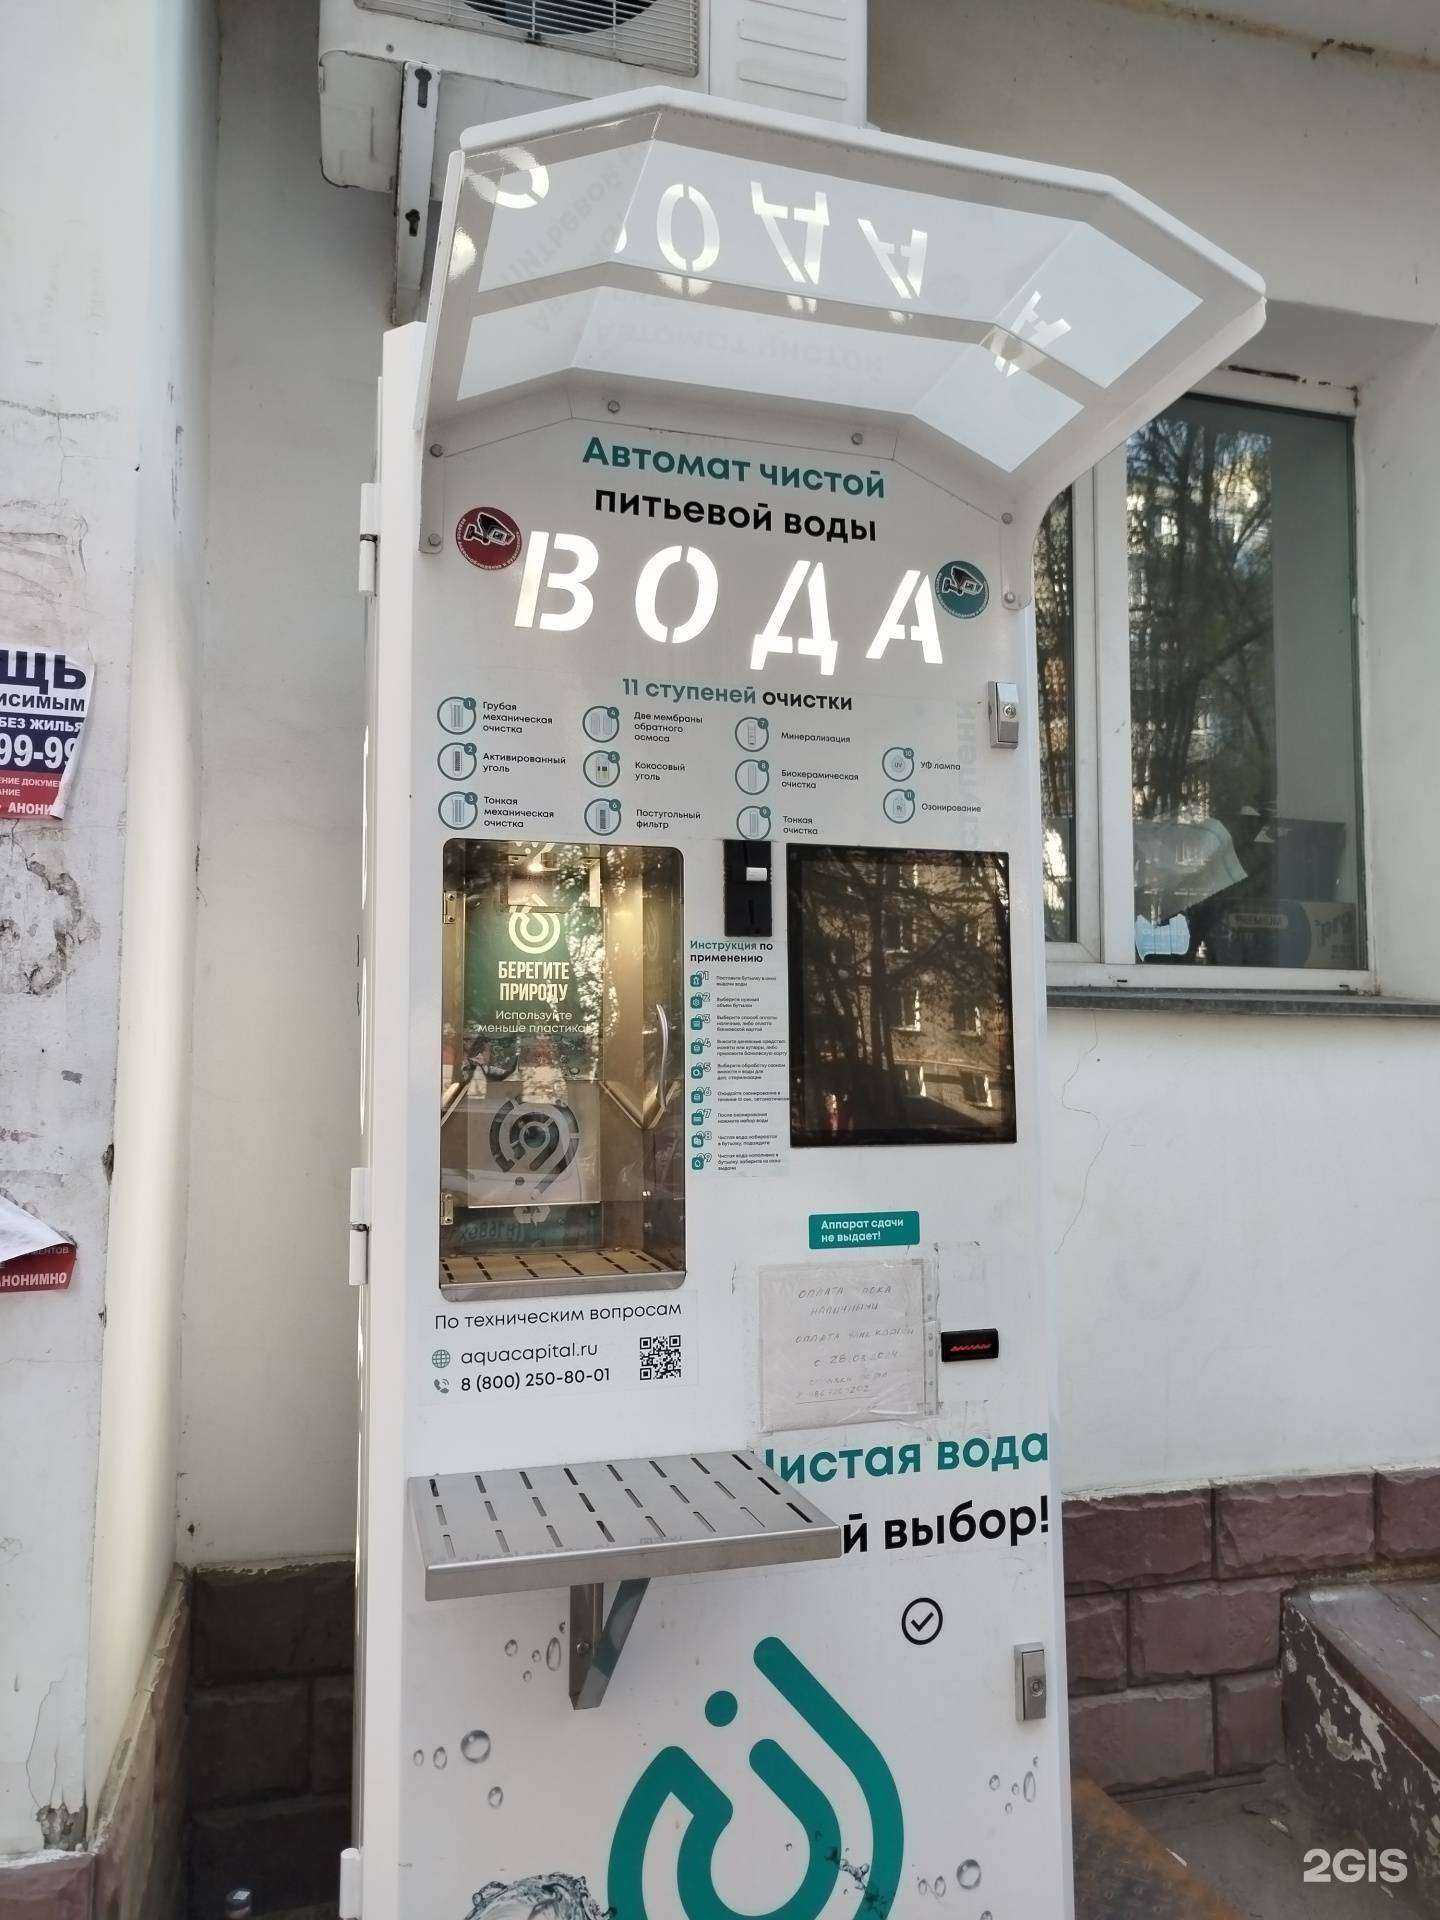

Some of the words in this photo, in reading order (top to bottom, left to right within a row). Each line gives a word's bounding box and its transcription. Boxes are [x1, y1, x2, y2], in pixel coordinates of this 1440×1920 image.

[582, 436, 751, 482] Автомат
[759, 463, 885, 498] чистой
[595, 489, 772, 532] питьевой
[784, 512, 876, 544] воды
[514, 530, 944, 676] ВОДА
[622, 678, 638, 696] 11
[645, 682, 756, 704] ступеней
[762, 691, 852, 711] очистки
[482, 701, 517, 711] Грубая
[482, 714, 553, 724] механическая
[633, 712, 651, 720] Две
[653, 713, 703, 724] мембраны
[482, 725, 523, 734] очистка
[634, 723, 683, 733] обратного
[634, 734, 670, 742] осмоса
[781, 732, 851, 743] Минерализация
[482, 752, 566, 764] Активированный
[482, 765, 510, 774] уголь
[635, 761, 686, 771] Кокосовый
[920, 761, 932, 769] УФ
[934, 763, 961, 771] лампа
[635, 773, 661, 781] уголь
[781, 770, 859, 781] Биокерамическая
[781, 781, 817, 789] очистка
[484, 796, 518, 805] Тонкая
[484, 809, 554, 818] механическая
[921, 803, 982, 813] Озонирование
[636, 809, 701, 820] Постугольный
[782, 815, 813, 824] Тонкая
[484, 820, 524, 828] очистка
[636, 820, 669, 829] фильтр
[783, 827, 818, 835] очистка
[690, 940, 757, 952] Инструкция
[759, 943, 773, 951] по
[690, 954, 764, 963] применению
[498, 961, 570, 980] БЕРЕГИТЕ
[499, 982, 568, 1003] ПРИРОДУ
[478, 1023, 526, 1033] меньше
[821, 1219, 870, 1233] Аппарат
[870, 1218, 904, 1230] сдачи
[821, 1233, 835, 1243] не
[837, 1230, 882, 1244] выдает!
[0, 1272, 67, 1287] НОНИМНО
[434, 1316, 459, 1329] По
[465, 1308, 584, 1328] техническим
[590, 1303, 682, 1322] вопросам
[461, 1342, 598, 1366] aquacapital.ru
[461, 1377, 471, 1391] 8
[476, 1372, 521, 1392] (800)
[526, 1367, 610, 1387] 250-80-01
[937, 1433, 1048, 1472] вода
[885, 1494, 1049, 1550] выбор!
